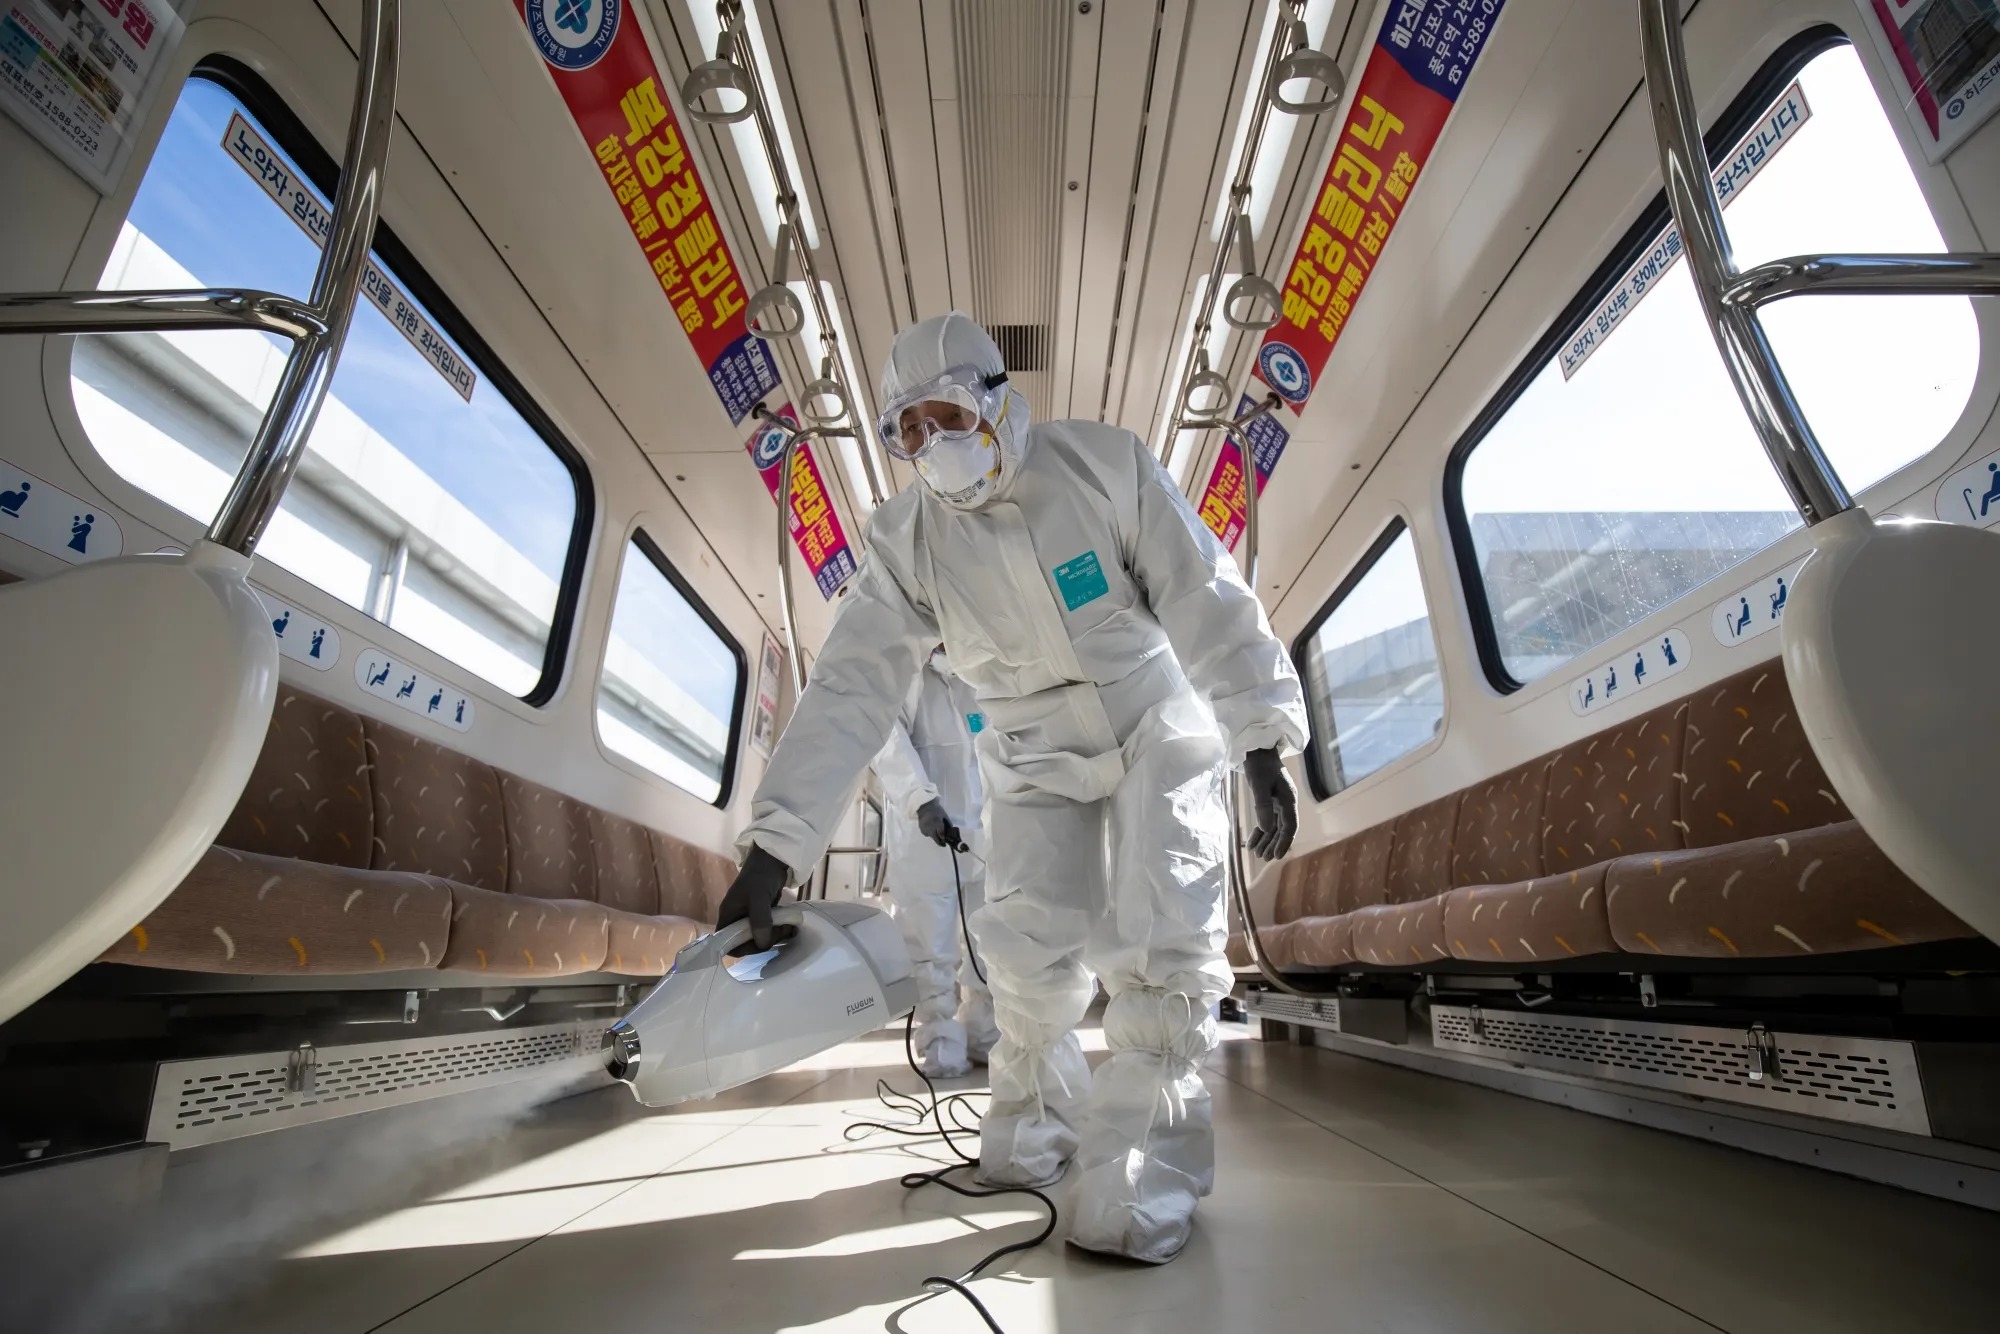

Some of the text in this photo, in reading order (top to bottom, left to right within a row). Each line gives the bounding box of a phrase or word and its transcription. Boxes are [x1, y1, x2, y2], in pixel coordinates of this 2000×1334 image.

[593, 0, 614, 47] OSPITAL
[1418, 0, 1451, 48] 김포시
[1428, 23, 1461, 76] 풍무역
[1, 60, 44, 102] 대표번호
[45, 101, 98, 150] 1588-0223
[1716, 100, 1799, 200] 좌석입니다
[619, 76, 744, 329] 복강경클리닉
[1282, 95, 1404, 330] 복강경클리닉
[595, 133, 660, 240] 하지정맥류
[653, 249, 683, 291] 담낭
[677, 297, 704, 334] 탈장
[1318, 262, 1364, 342] 하지정맥류
[1359, 210, 1388, 256] 담낭
[1384, 151, 1418, 203] 탈장
[395, 303, 418, 336] 위한
[420, 331, 470, 392] 좌석입니다
[733, 352, 751, 379] 김포시
[742, 335, 773, 389] 히즈메디병원
[720, 356, 737, 383] 풍무역
[731, 378, 742, 396] 2번
[1258, 432, 1271, 446] 2번
[1264, 430, 1285, 464] 1588-0223
[1058, 567, 1069, 577] 3M
[846, 996, 875, 1016] FLUGUN
